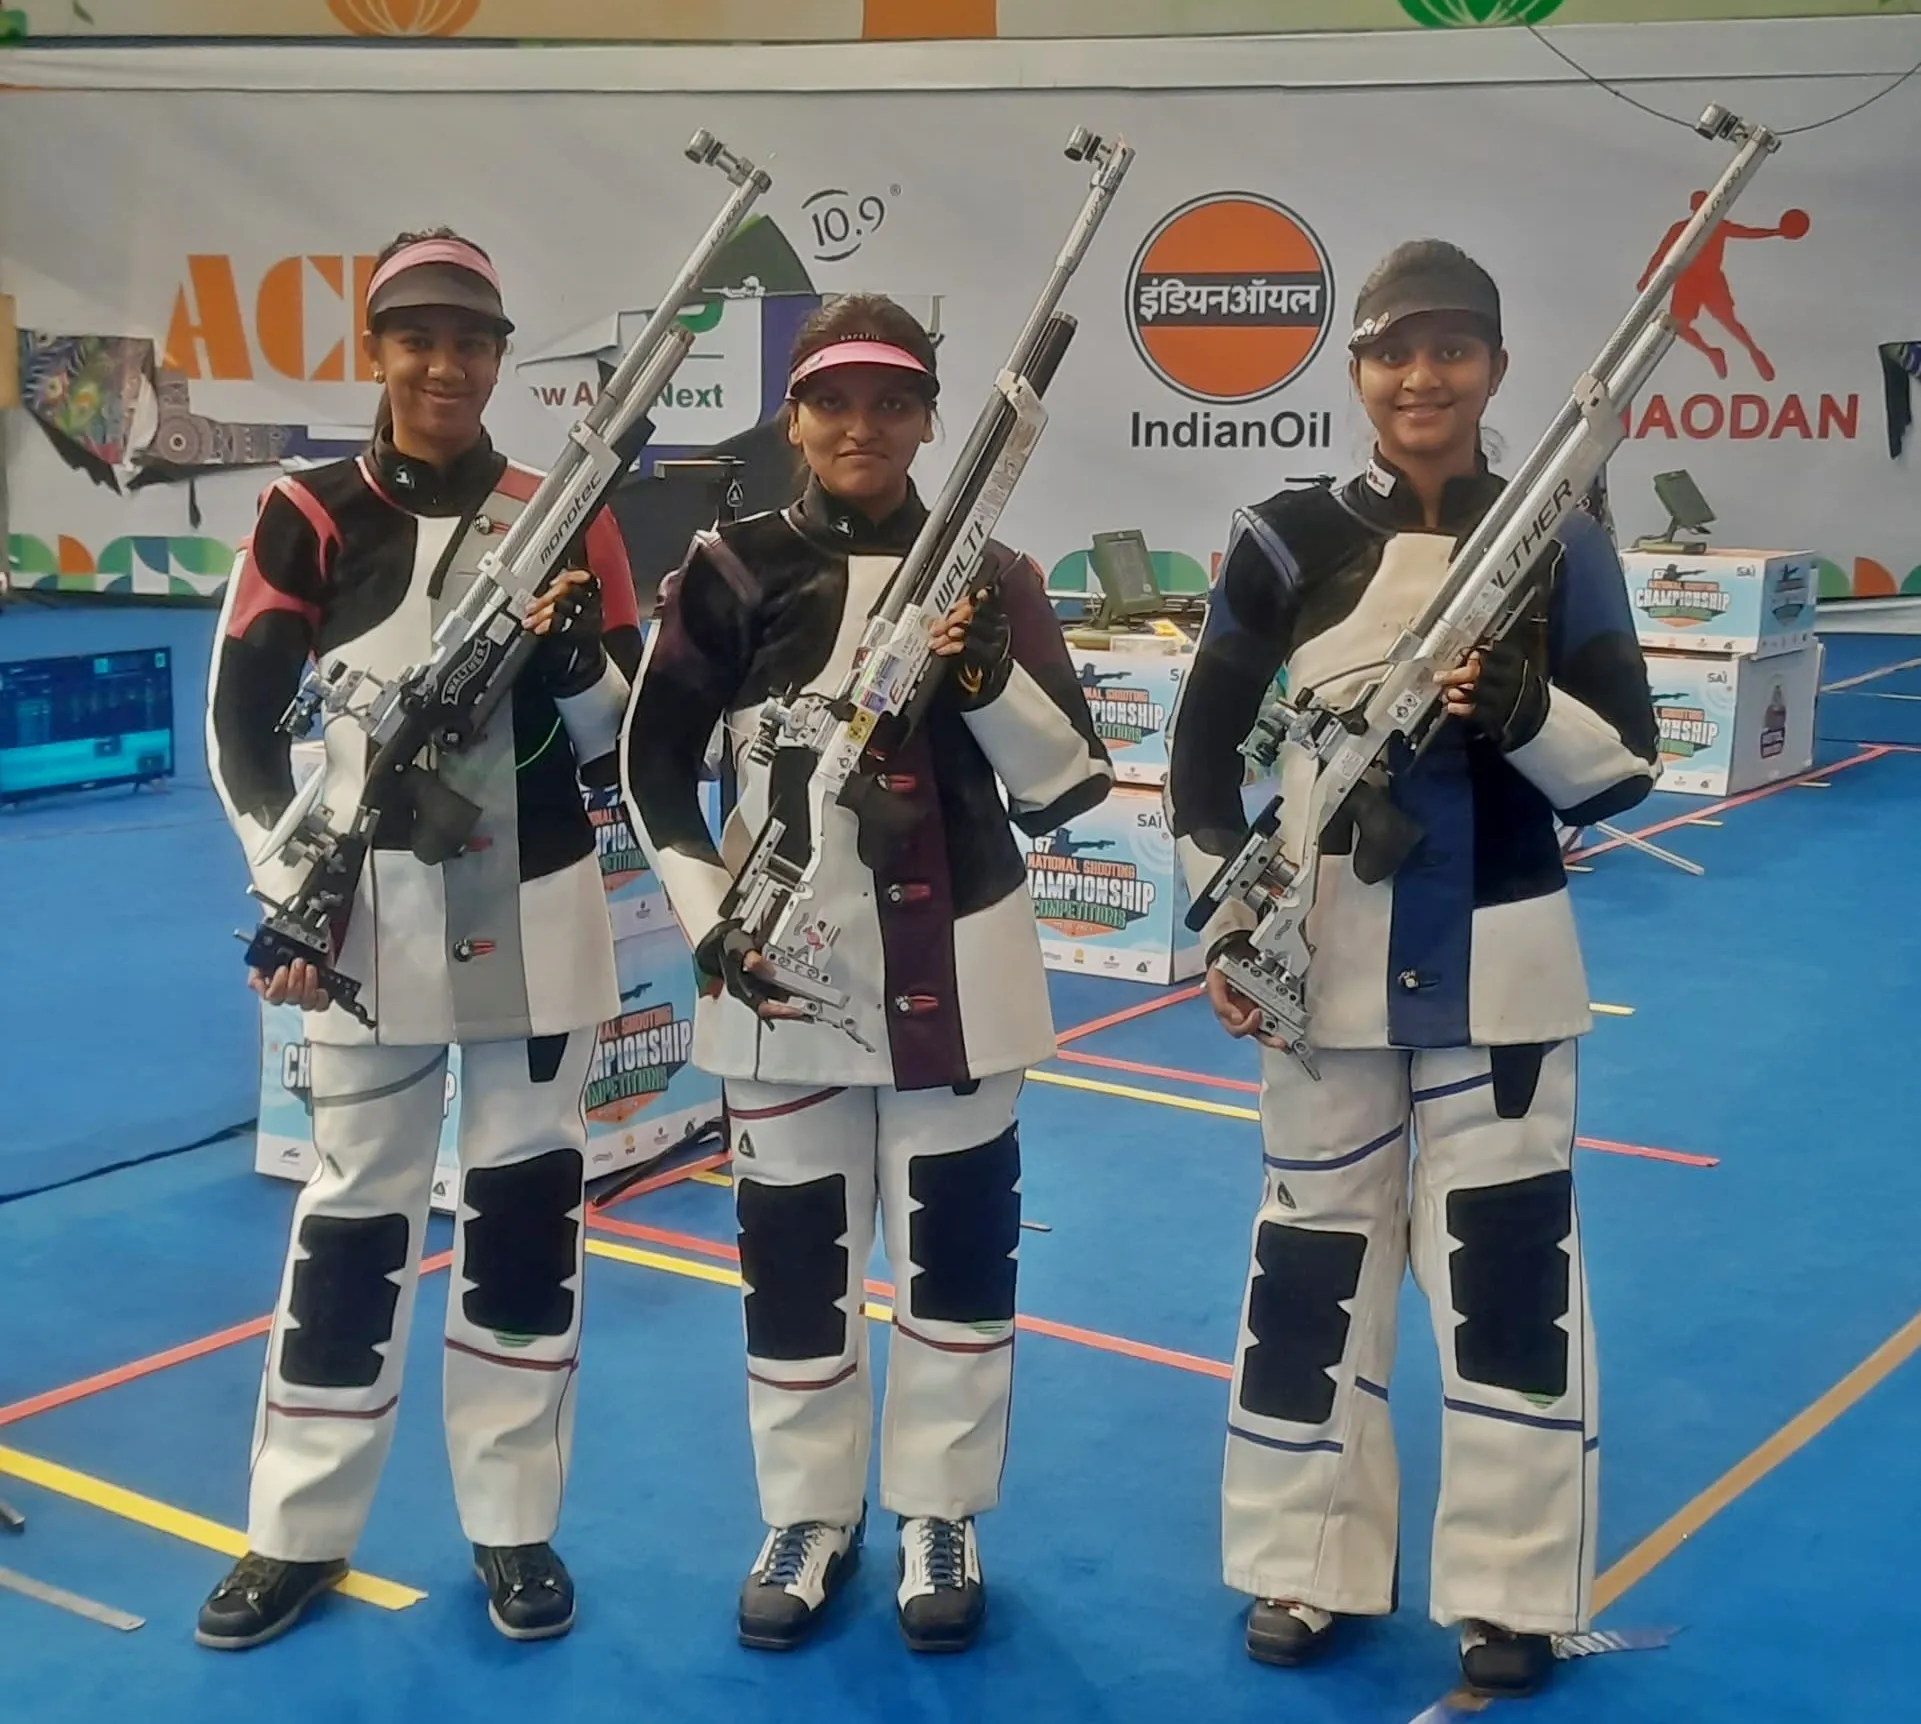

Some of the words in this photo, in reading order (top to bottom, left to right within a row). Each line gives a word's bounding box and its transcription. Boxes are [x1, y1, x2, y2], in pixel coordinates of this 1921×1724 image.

[811, 195, 886, 247] 10.9
[1139, 278, 1321, 322] इंडियनऑयल
[1131, 411, 1331, 448] IndianOil
[541, 471, 602, 564] monotec
[1491, 479, 1573, 589] LTHER
[1636, 589, 1730, 611] CHAMPIONSHIP
[446, 648, 485, 694] WALTHER
[1027, 854, 1081, 874] NATIONAL
[1082, 860, 1136, 880] SHOOTING
[1027, 869, 1155, 915] AMPIONSHIP
